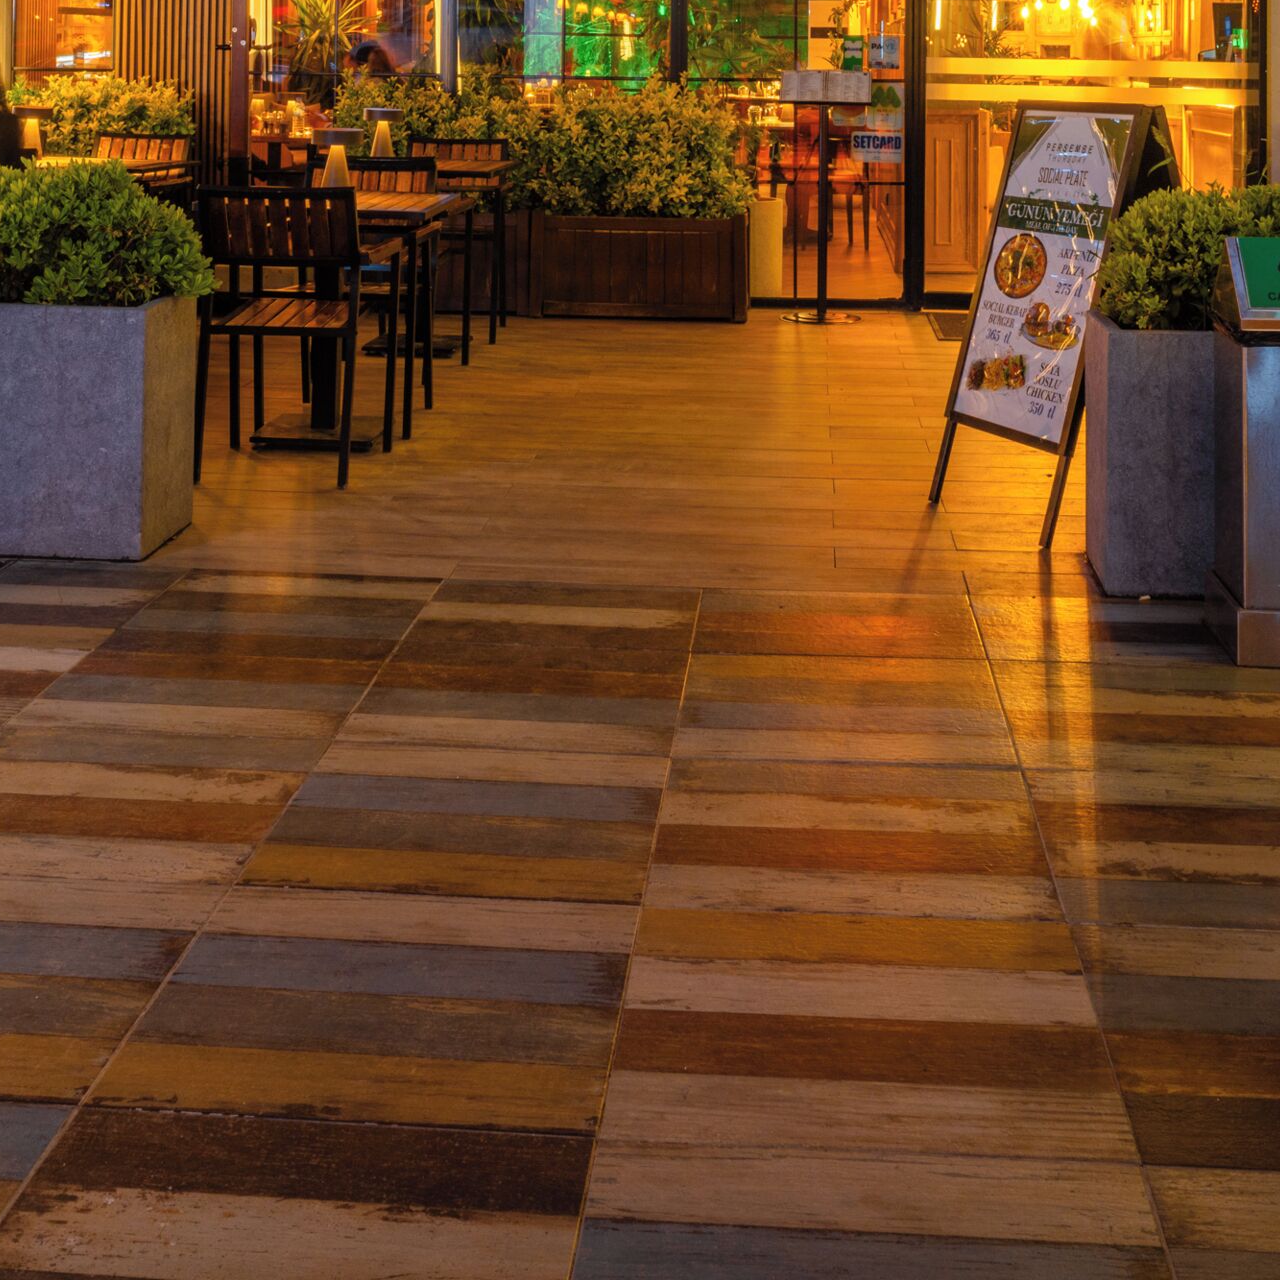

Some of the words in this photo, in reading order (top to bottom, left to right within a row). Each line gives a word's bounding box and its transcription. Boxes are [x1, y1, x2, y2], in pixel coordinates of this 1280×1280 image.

[853, 135, 901, 149] SETCARD
[1038, 167, 1063, 185] SOCIAL
[1064, 169, 1089, 187] PLATE
[1008, 201, 1054, 221] GÜNÜN
[983, 300, 1005, 313] SOCIAL
[988, 314, 1015, 328] BURGER
[1026, 385, 1064, 403] CHICKEN
[1028, 401, 1044, 416] 350
